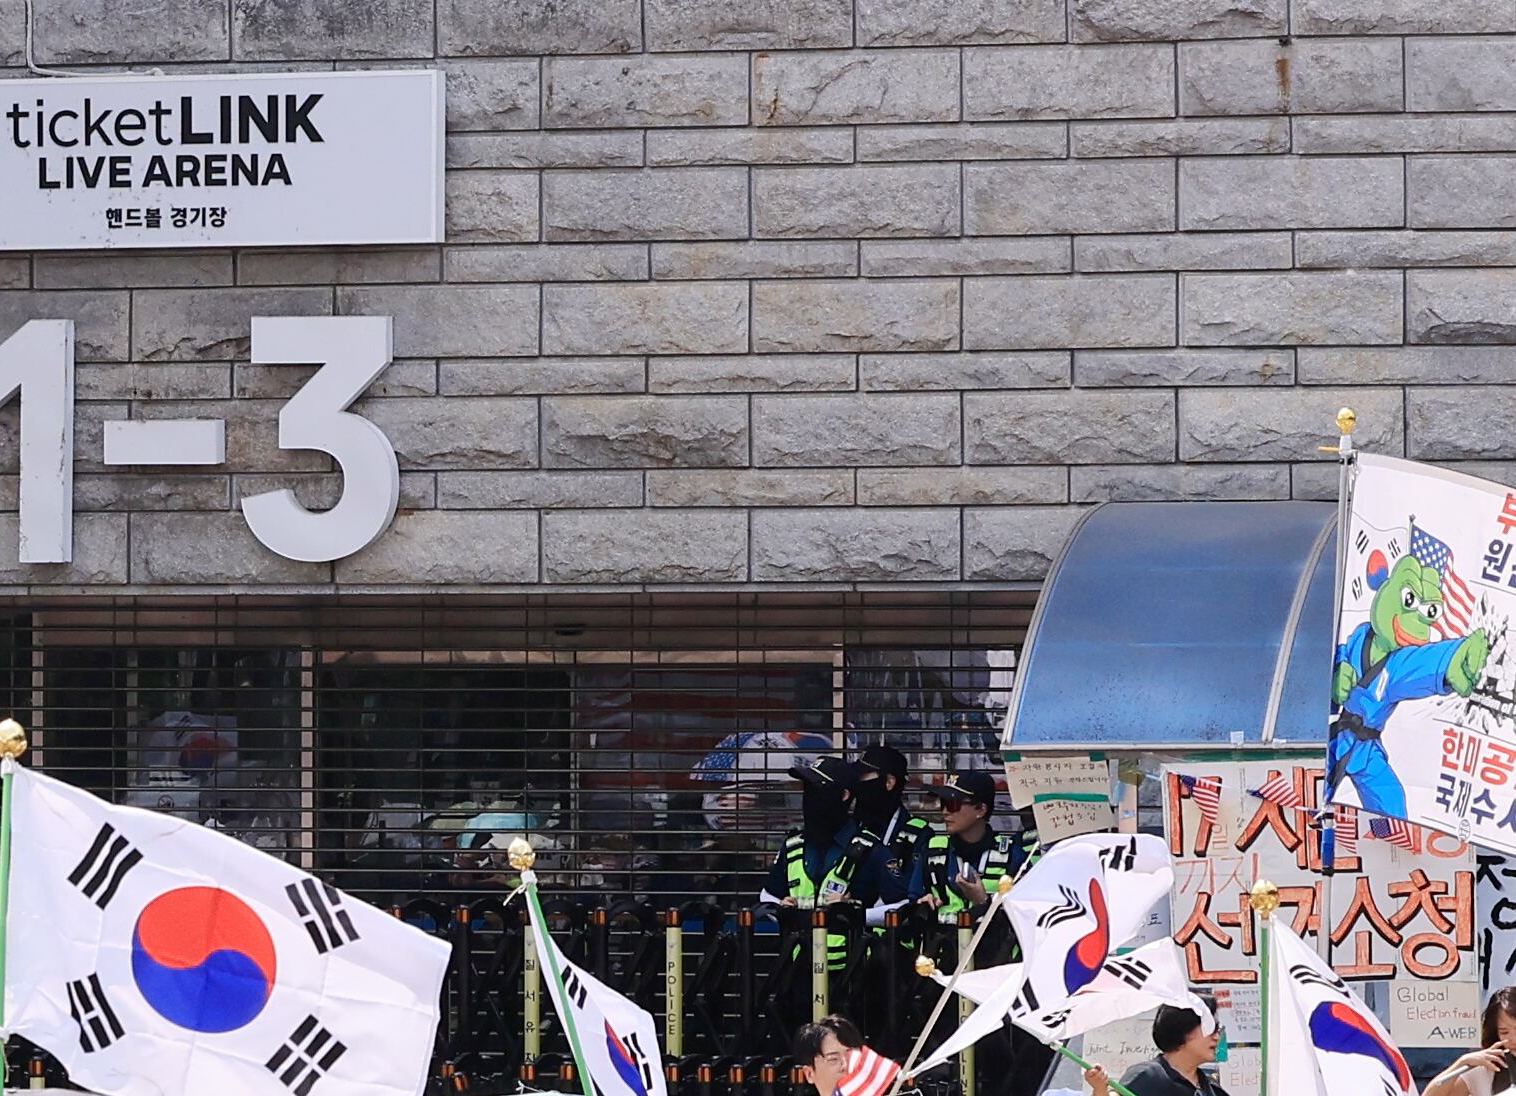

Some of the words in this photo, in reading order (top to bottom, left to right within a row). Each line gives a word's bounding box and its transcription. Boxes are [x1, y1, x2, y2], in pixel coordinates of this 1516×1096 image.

[7, 93, 324, 149] ticketLINK
[38, 155, 132, 190] LIVE
[141, 153, 293, 188] ARENA
[105, 207, 162, 229] 핸드볼
[170, 206, 227, 228] 경기장
[1483, 537, 1516, 586] 원
[1441, 726, 1516, 788] 한미공
[668, 961, 677, 1035] POLICE
[1396, 985, 1450, 1003] Global
[1427, 1025, 1477, 1041] A-WEB
[1226, 1053, 1262, 1070] Glob
